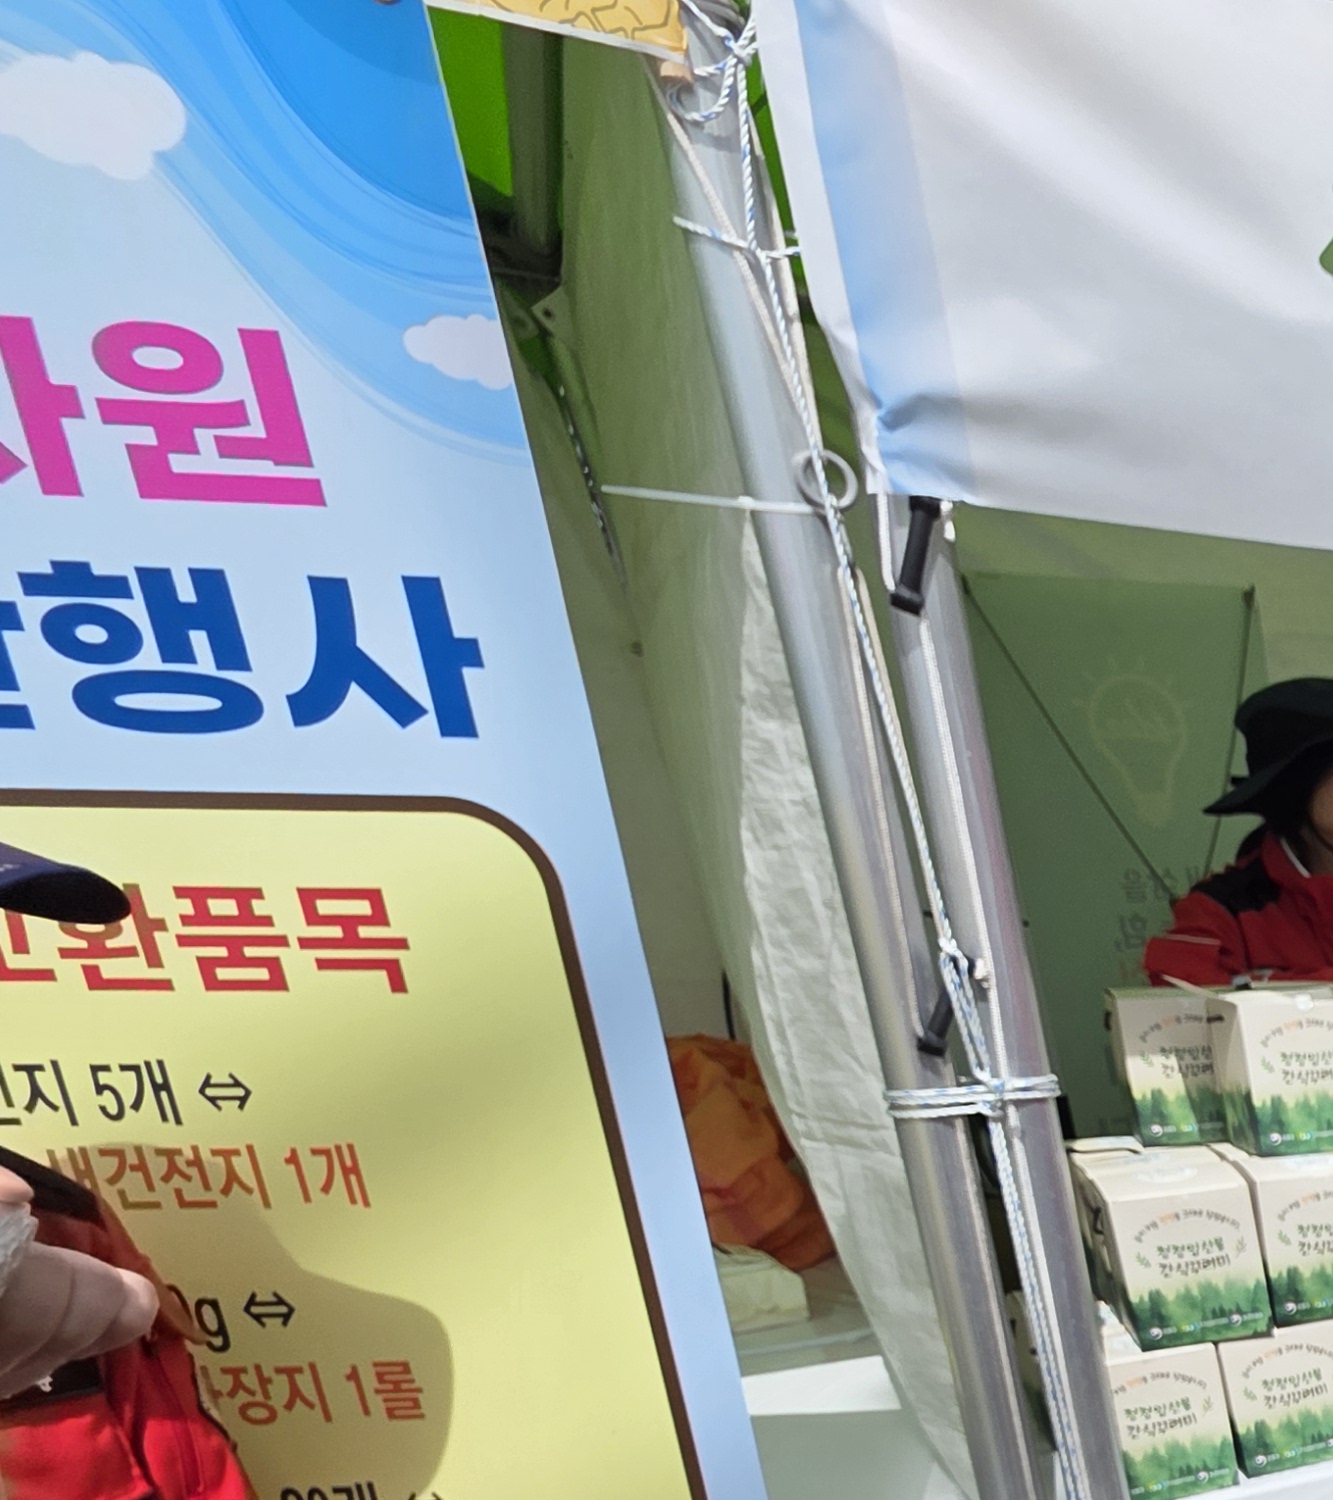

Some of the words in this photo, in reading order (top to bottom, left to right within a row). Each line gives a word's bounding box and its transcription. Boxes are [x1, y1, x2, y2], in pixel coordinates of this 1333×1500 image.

[0, 559, 486, 740] 행사
[89, 1059, 184, 1127] 5개
[284, 1143, 371, 1208] 1개
[344, 1360, 426, 1421] 1롤
